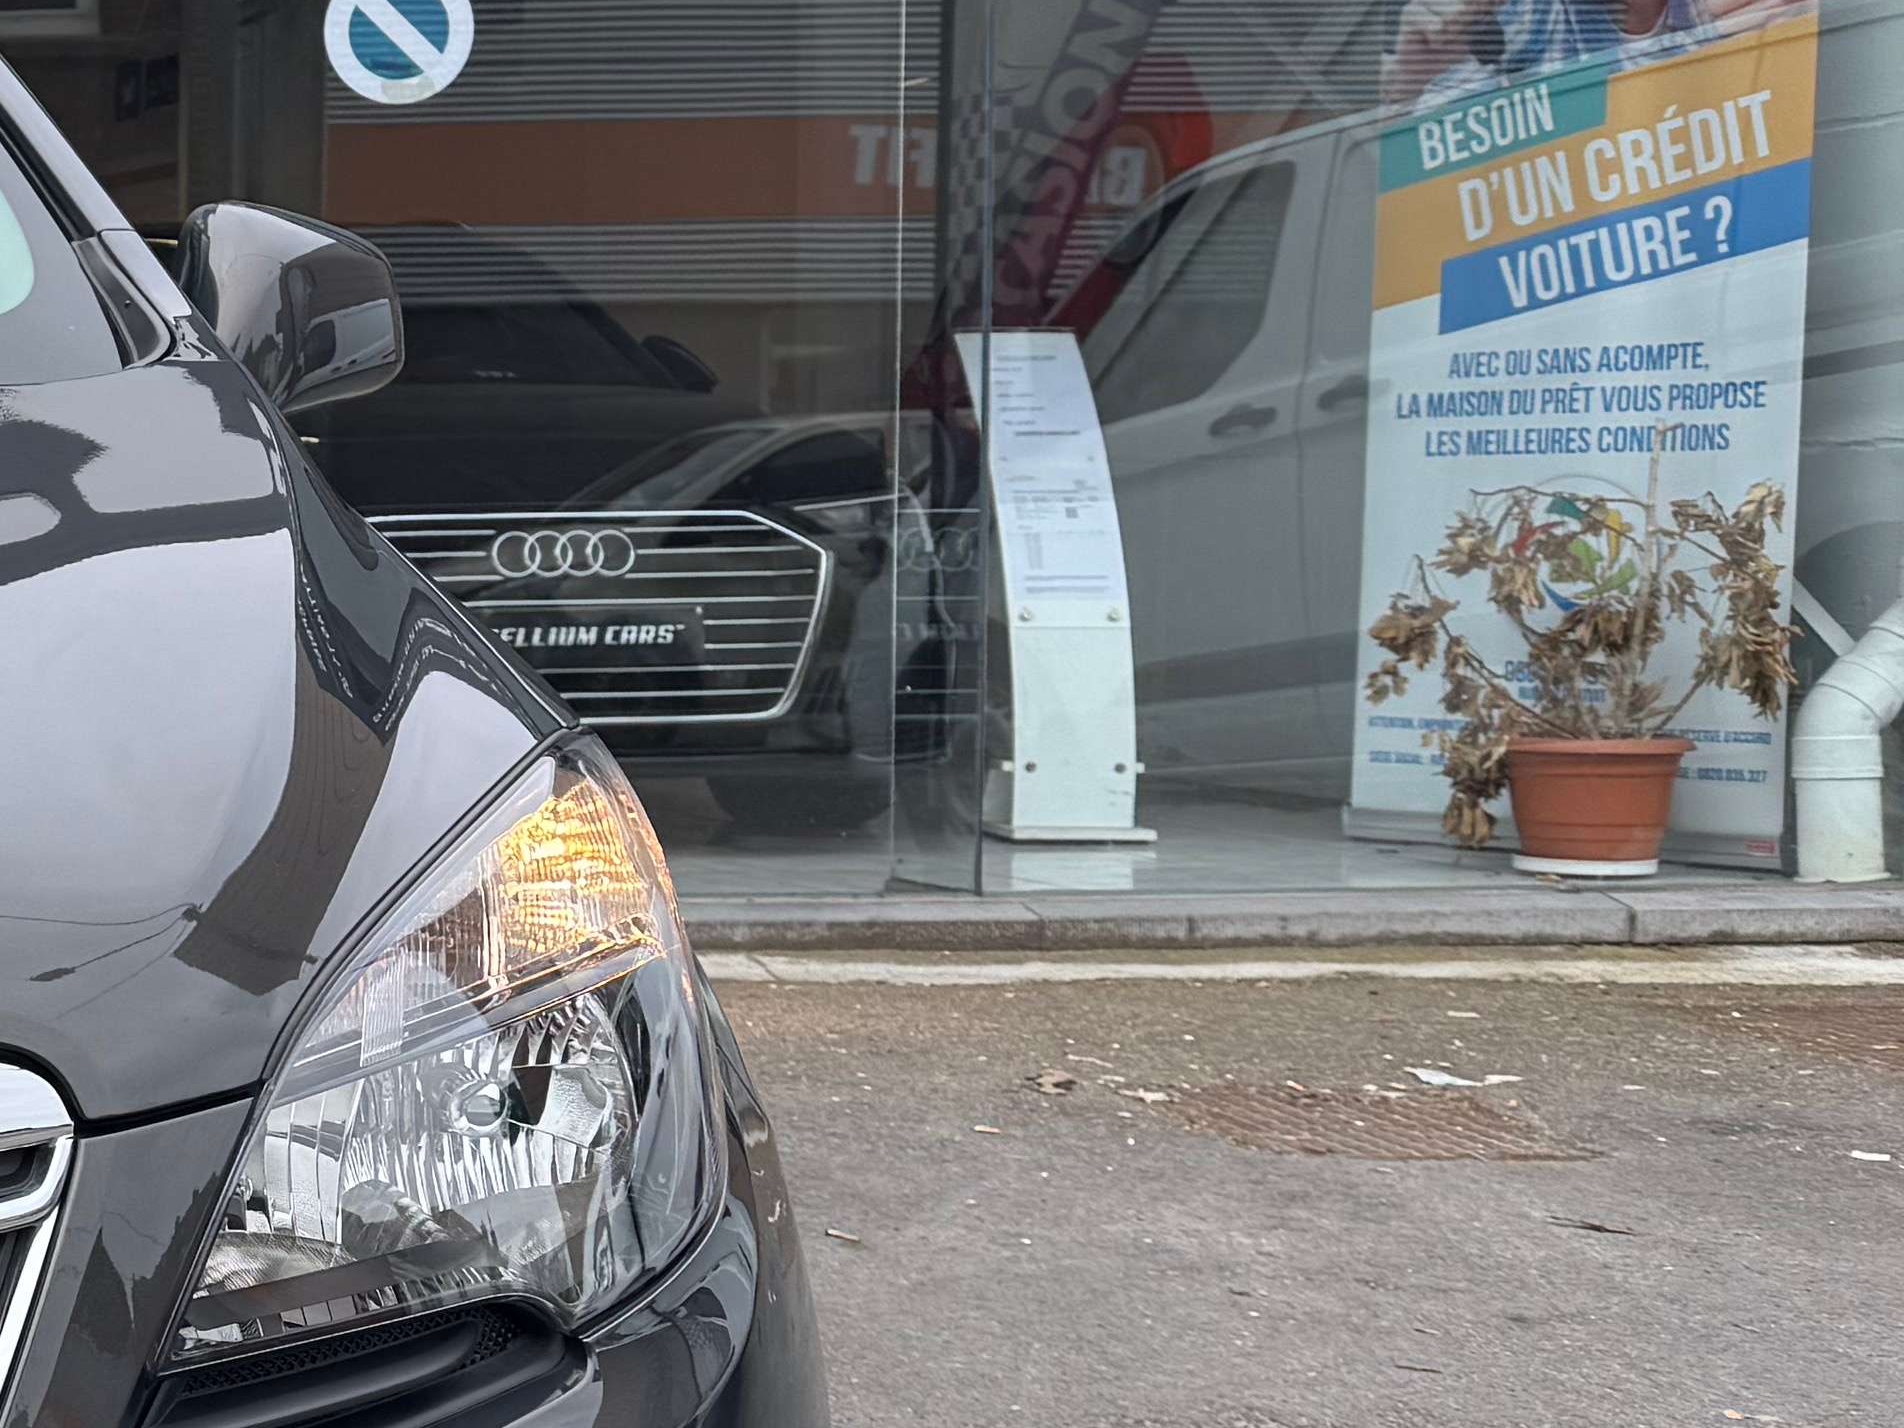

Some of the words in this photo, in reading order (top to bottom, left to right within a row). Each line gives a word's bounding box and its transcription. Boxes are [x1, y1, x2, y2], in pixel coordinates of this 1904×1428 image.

[1418, 84, 1555, 170] BESOIN
[1458, 150, 1575, 243] D'UN
[1583, 90, 1772, 203] CRÉDIT
[1497, 205, 1699, 309] VOITURE
[1703, 195, 1734, 253] ?
[1448, 350, 1500, 379] AVEC
[1505, 349, 1533, 376] OU
[1536, 346, 1592, 375] SANS
[1597, 342, 1710, 373] ACOMPTE,
[1395, 392, 1422, 420] LA
[1426, 389, 1504, 418] MAISON
[1508, 388, 1536, 416] DU
[1540, 382, 1596, 415] PRÊT
[1600, 384, 1662, 413] VOUS
[1668, 381, 1768, 412] PROPOSE
[1425, 430, 1462, 458] LES
[1465, 427, 1591, 457] MEILLEURES
[604, 624, 676, 646] CARS
